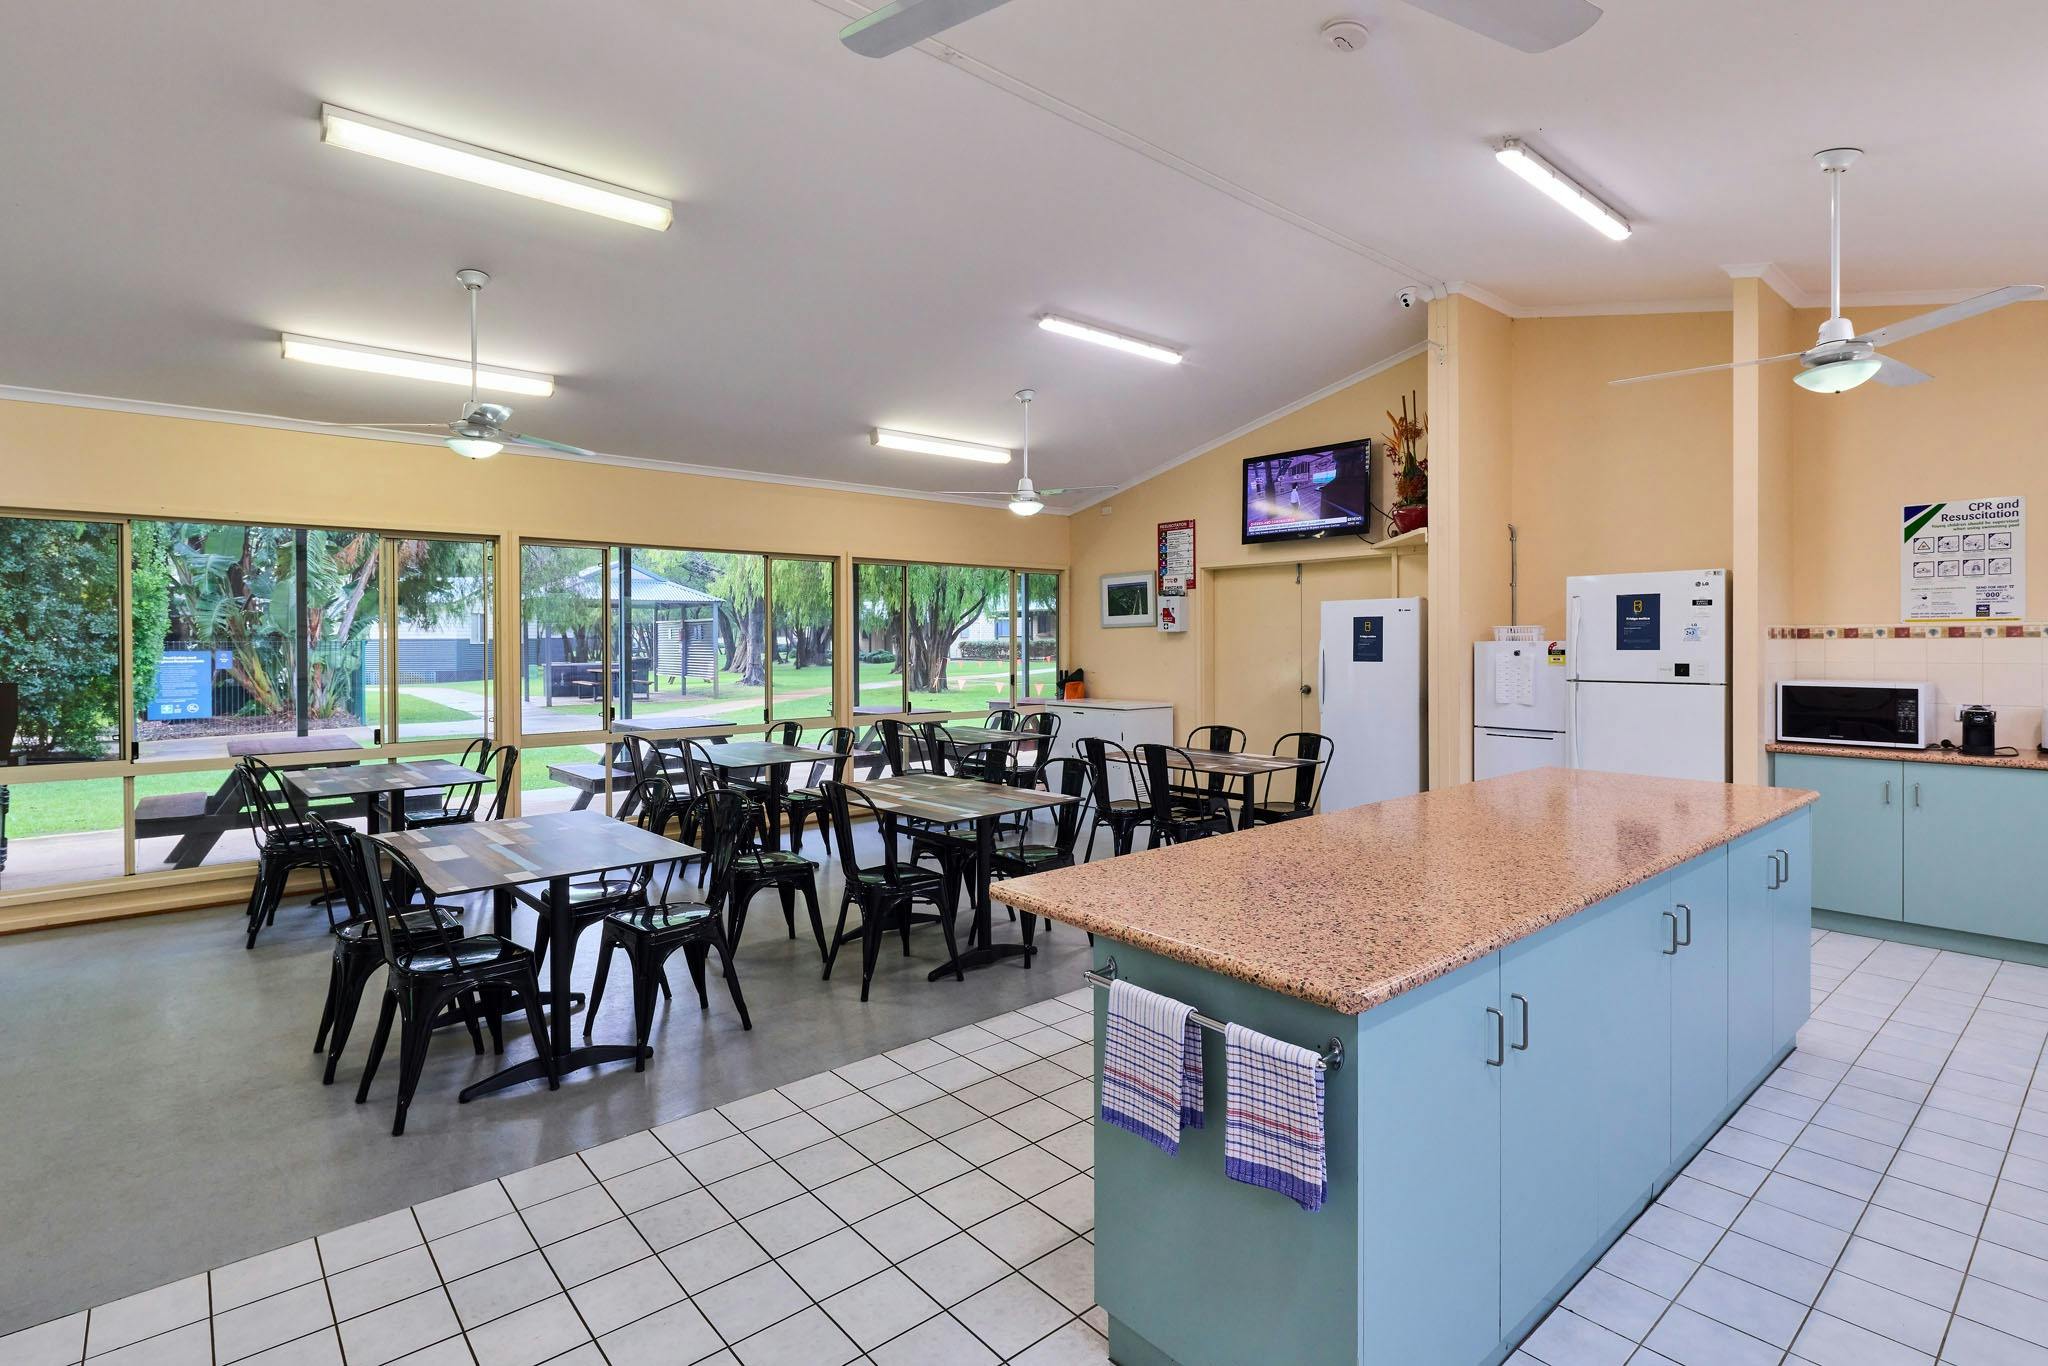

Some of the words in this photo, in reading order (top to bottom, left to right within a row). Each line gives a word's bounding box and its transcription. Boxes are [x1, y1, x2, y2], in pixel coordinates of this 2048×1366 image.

[1969, 501, 1992, 512] CPR
[1997, 499, 2019, 509] and
[1941, 510, 2019, 522] Resuscitation
